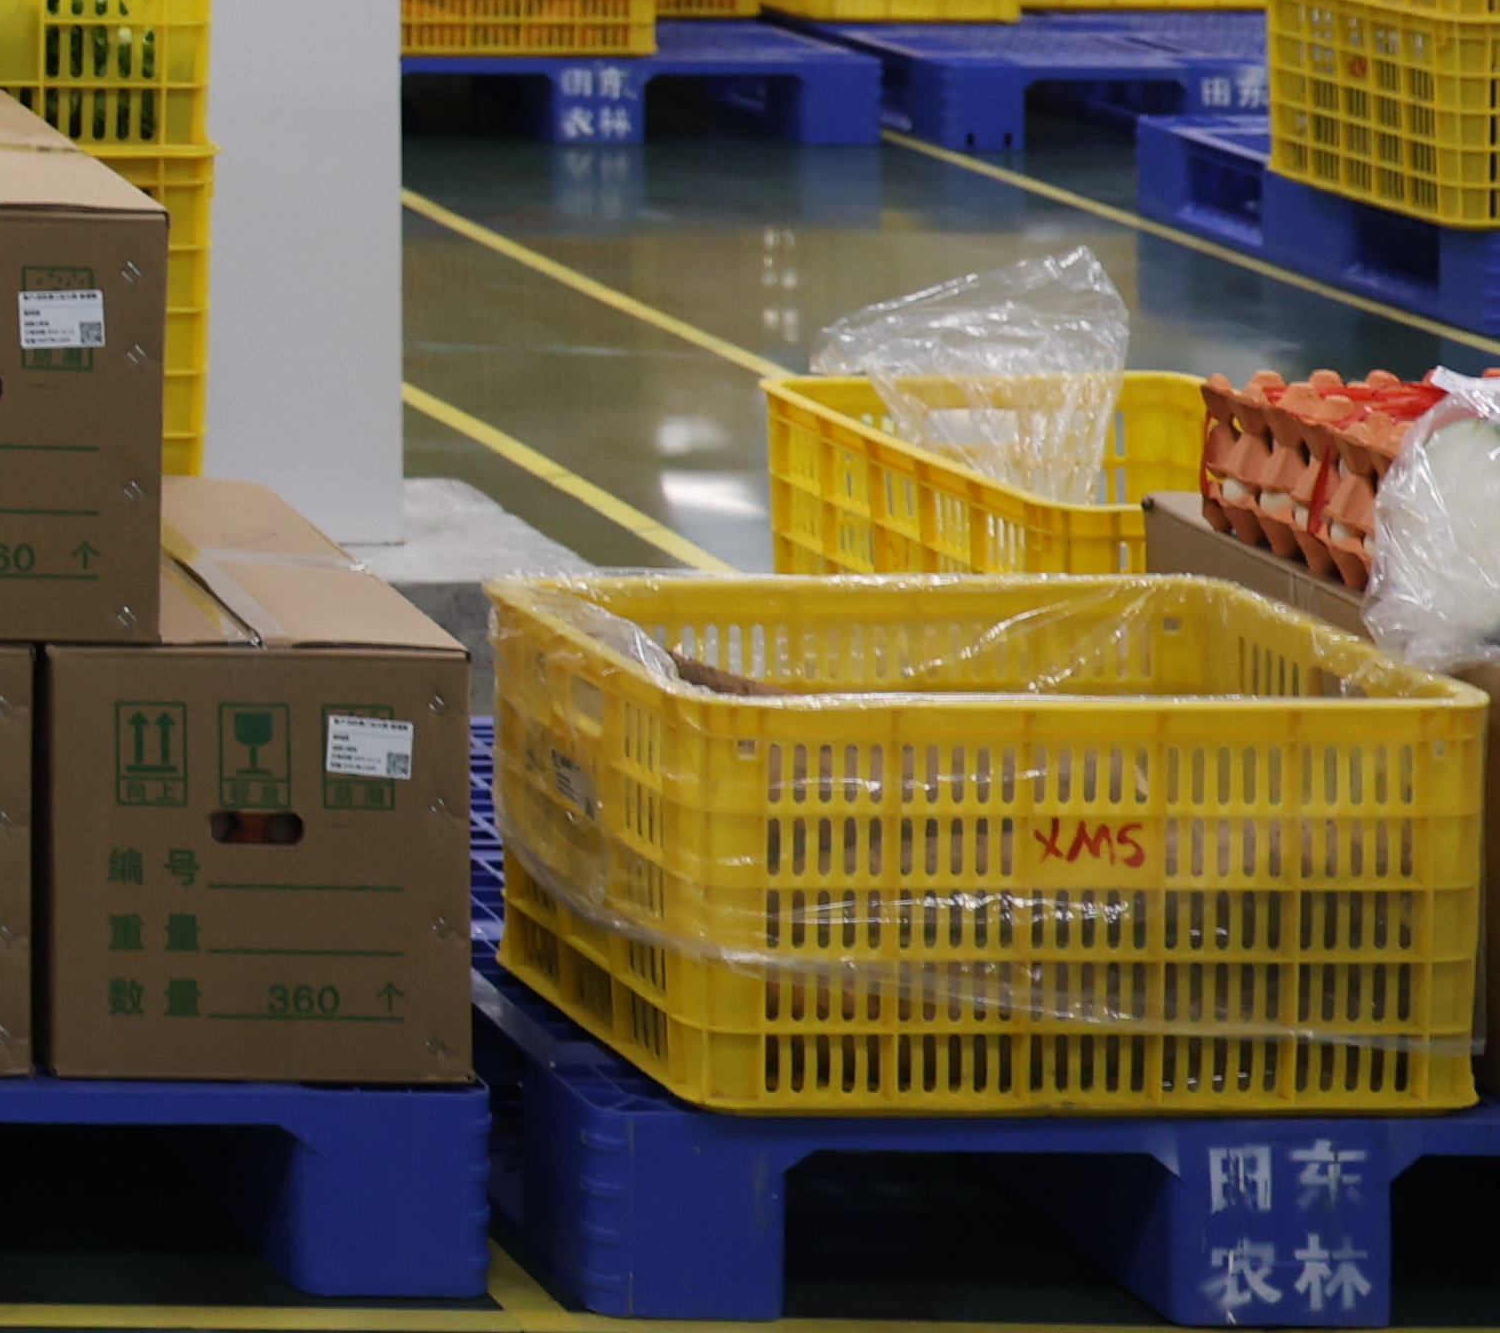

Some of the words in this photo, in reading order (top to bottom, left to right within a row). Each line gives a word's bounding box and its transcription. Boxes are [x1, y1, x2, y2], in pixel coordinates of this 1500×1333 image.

[1034, 817, 1146, 869] XMS
[108, 847, 200, 886] 编号
[108, 913, 201, 951] 重量
[108, 978, 201, 1016] 数量
[268, 984, 340, 1014] 360
[1209, 1138, 1367, 1215] 田东
[1205, 1233, 1372, 1311] 农林
